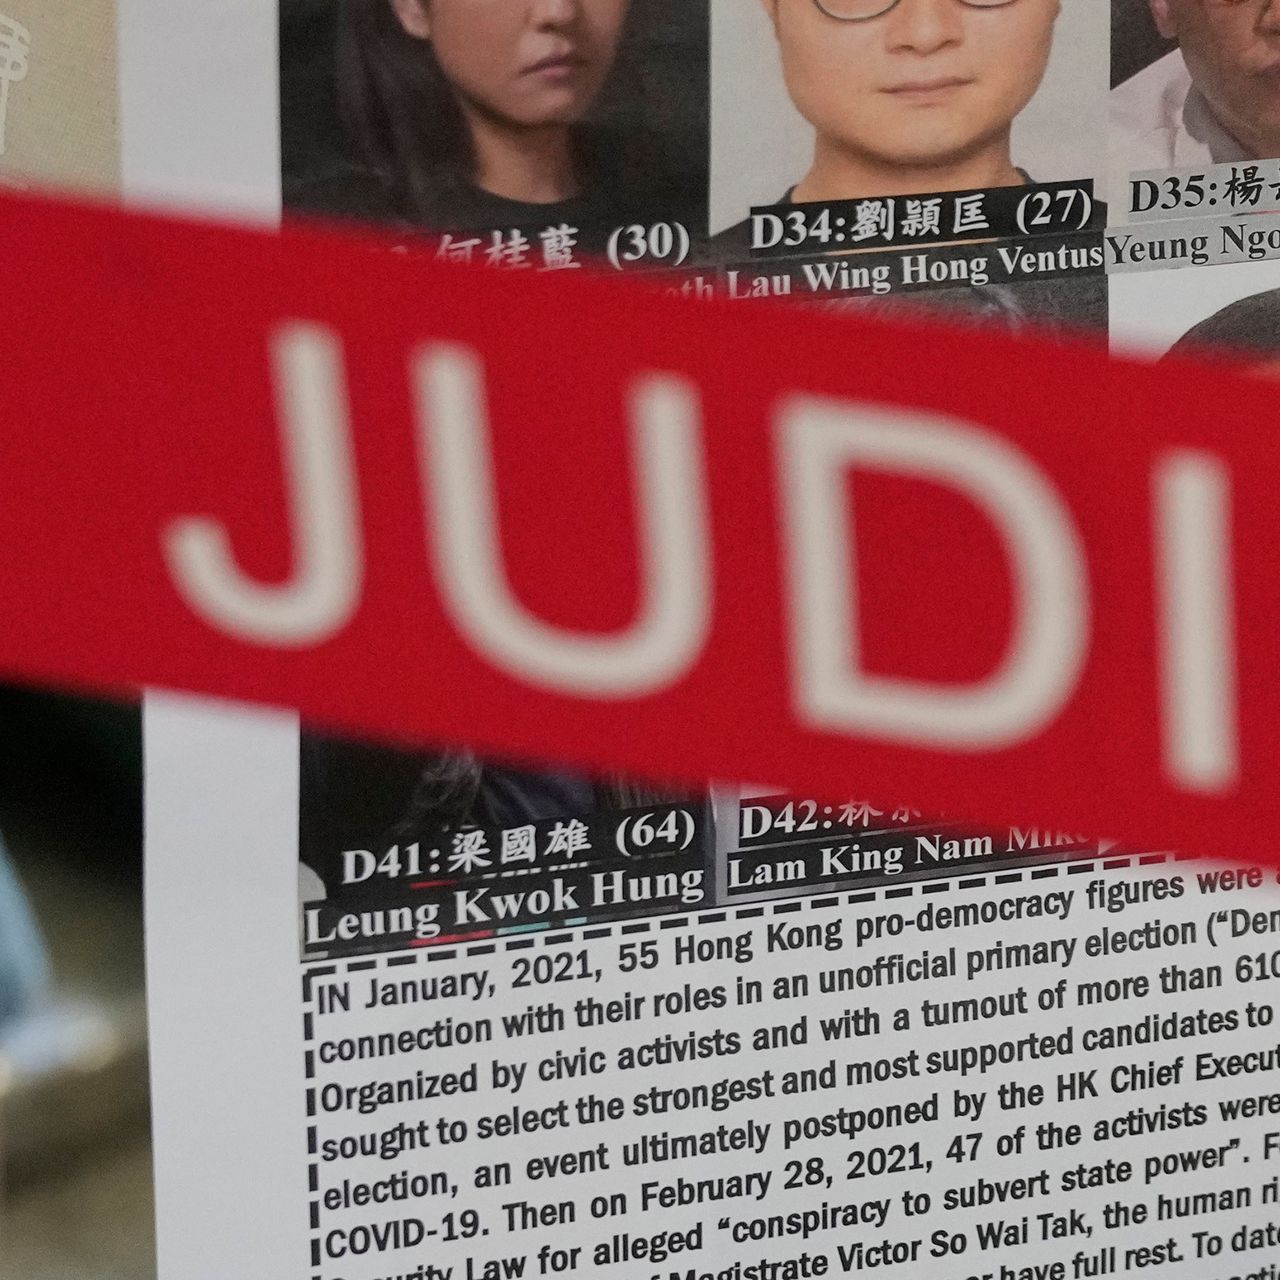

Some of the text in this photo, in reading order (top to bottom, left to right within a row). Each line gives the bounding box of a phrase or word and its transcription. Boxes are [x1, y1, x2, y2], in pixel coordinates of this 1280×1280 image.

[607, 221, 691, 269] (30)
[1015, 188, 1094, 234] (27)
[727, 266, 793, 300] Lau
[803, 261, 891, 300] Wing
[901, 254, 989, 292] Hong
[997, 243, 1103, 277] Ventus
[1106, 232, 1208, 266] Yeung
[341, 810, 696, 885] D41:梁國雄 (64)
[728, 857, 806, 888] Lam
[820, 844, 903, 875] King
[914, 833, 993, 864] Nam
[306, 867, 704, 946] Leung Kwok Hung
[318, 983, 351, 1014] IN
[365, 970, 496, 1008] January,
[511, 949, 602, 988] 2021,
[618, 940, 659, 973] 55
[675, 933, 753, 964] Hong
[767, 919, 843, 951] Kong
[856, 889, 1074, 947] pro-democracy
[1086, 874, 1185, 912] figures
[1197, 865, 1263, 895] were
[319, 1017, 492, 1065] connection
[502, 1005, 565, 1038] with
[575, 992, 646, 1028] their
[654, 984, 727, 1018] roles
[736, 976, 762, 1005] in
[772, 973, 809, 1000] an
[818, 947, 956, 995] unofficial
[967, 937, 1077, 980] primary
[1085, 920, 1197, 958] election
[320, 1063, 478, 1115] Organized
[492, 1059, 528, 1094] by
[538, 1047, 606, 1082] civic
[617, 1028, 742, 1070] activists
[752, 1021, 808, 1051] and
[820, 1007, 880, 1041] with
[893, 1008, 910, 1031] a
[921, 987, 1028, 1028] turnout
[1038, 979, 1067, 1011] of
[1077, 972, 1149, 1007] more
[1159, 963, 1222, 994] than
[321, 1122, 429, 1162] sought
[436, 1117, 468, 1145] to
[476, 1098, 569, 1141] select
[576, 1092, 625, 1124] the
[633, 1070, 775, 1118] strongest
[781, 1060, 837, 1095] and
[847, 1050, 920, 1085] most
[926, 1026, 1073, 1077] supported
[1082, 1007, 1239, 1052] candidates
[1246, 1001, 1274, 1028] to
